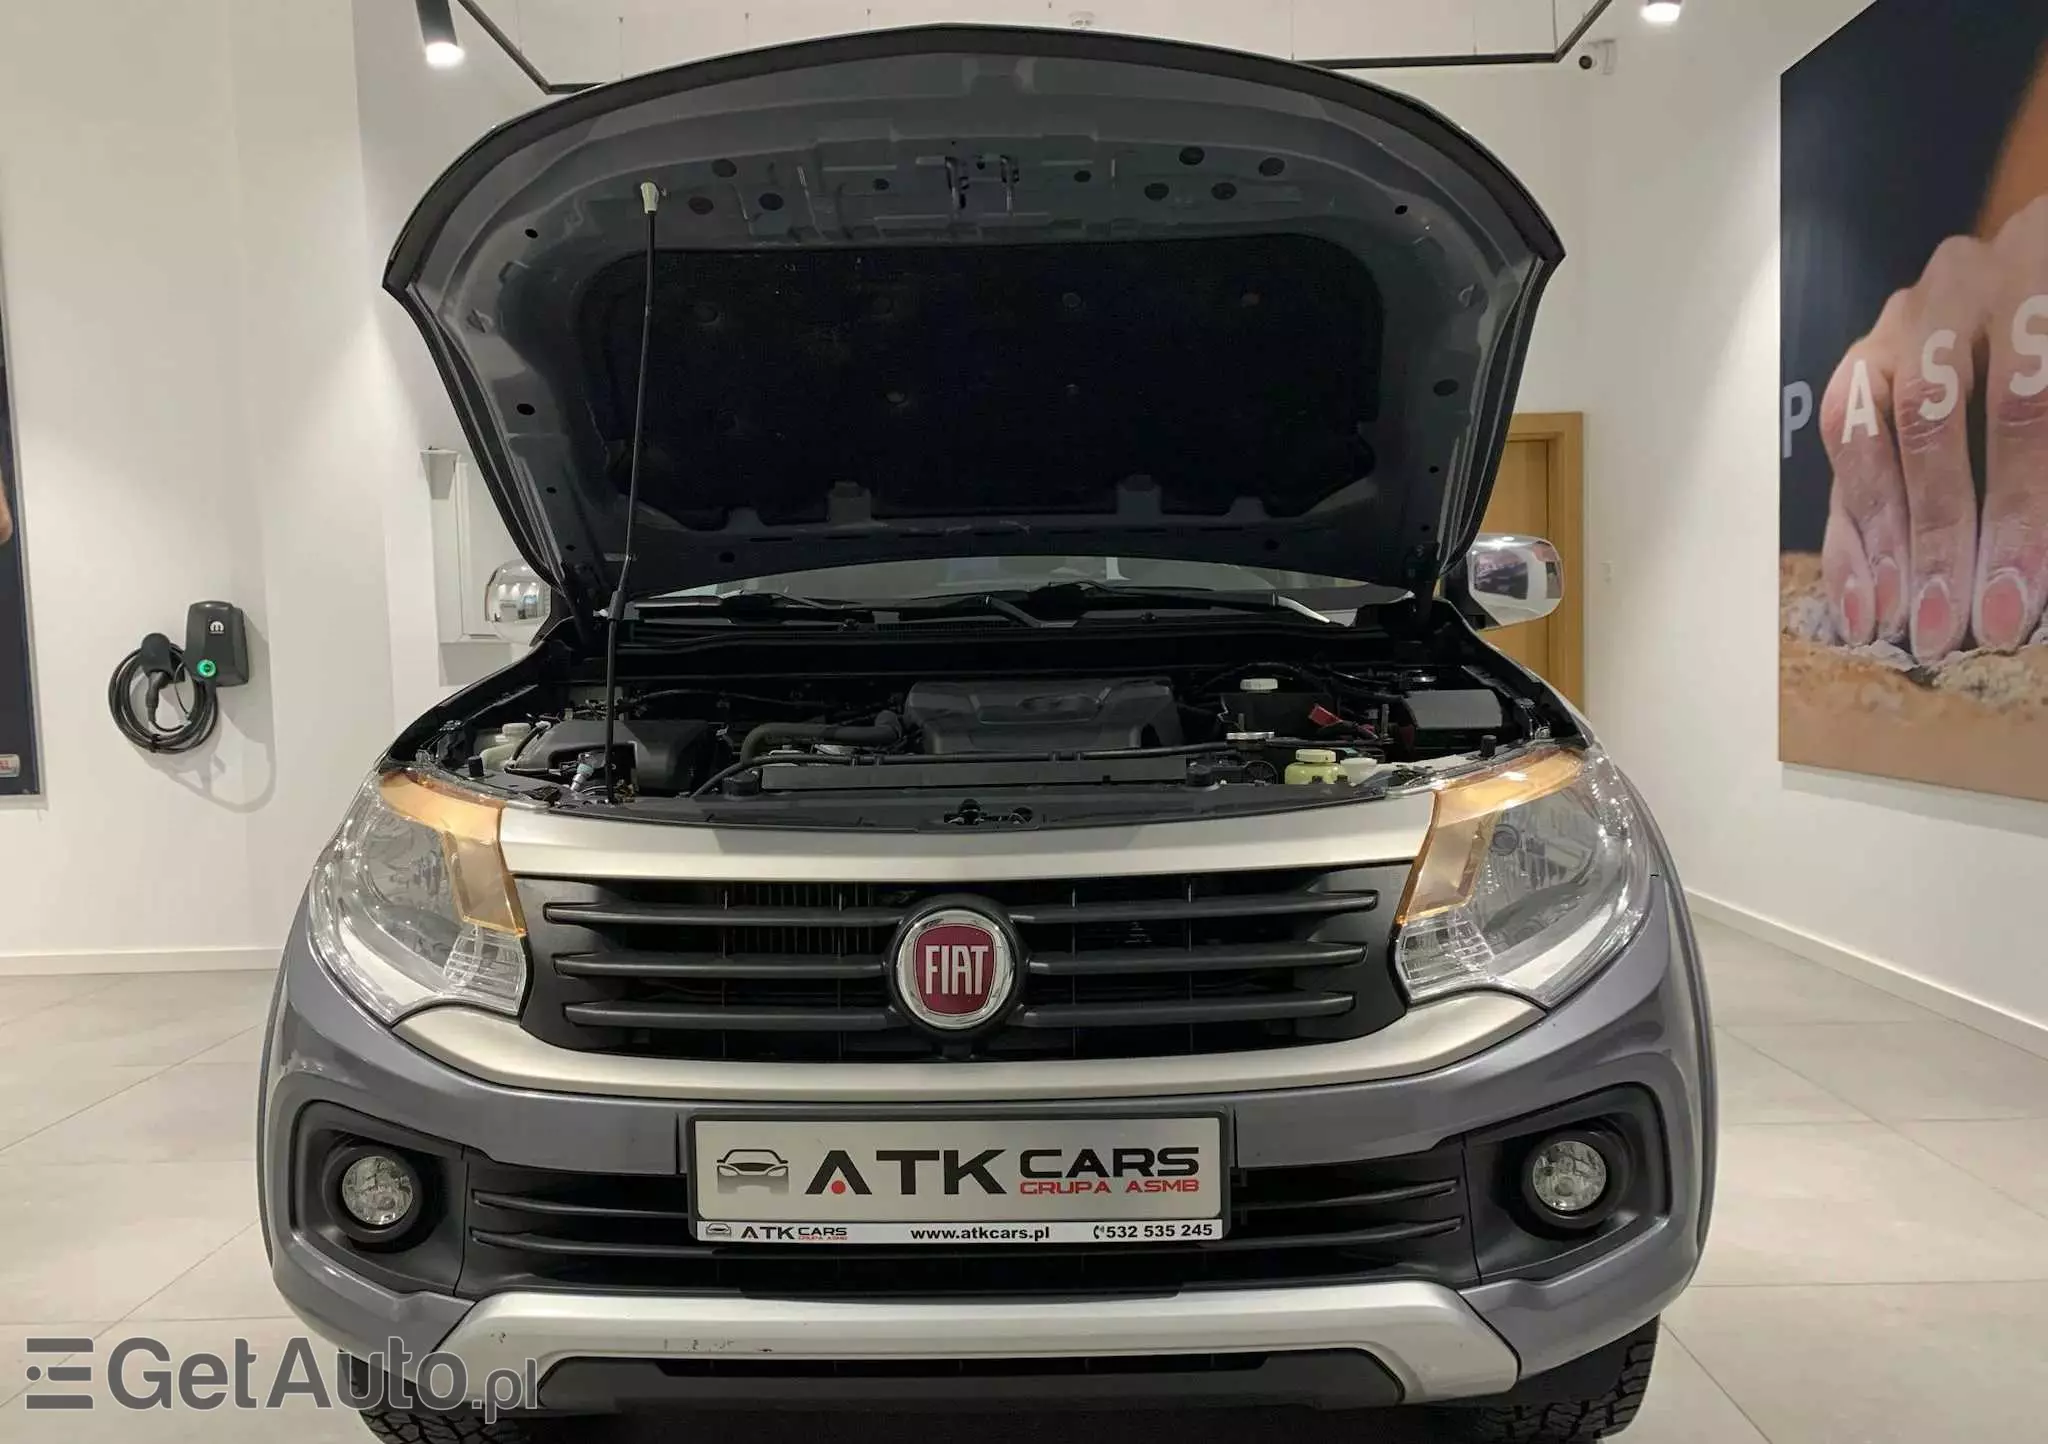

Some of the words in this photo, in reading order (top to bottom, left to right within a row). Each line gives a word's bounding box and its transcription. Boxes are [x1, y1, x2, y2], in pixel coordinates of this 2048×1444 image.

[925, 945, 989, 995] FIAT
[804, 1149, 1007, 1195] ATK
[1020, 1147, 1199, 1178] CARS
[1020, 1180, 1112, 1195] GRUPA
[1125, 1179, 1199, 1194] ASMB
[741, 1226, 795, 1240] ATK
[798, 1227, 848, 1236] CARS
[910, 1226, 1050, 1242] www.atkcars.pl
[1106, 1226, 1138, 1239] 532
[1144, 1225, 1175, 1238] 535
[1181, 1224, 1213, 1237] 245
